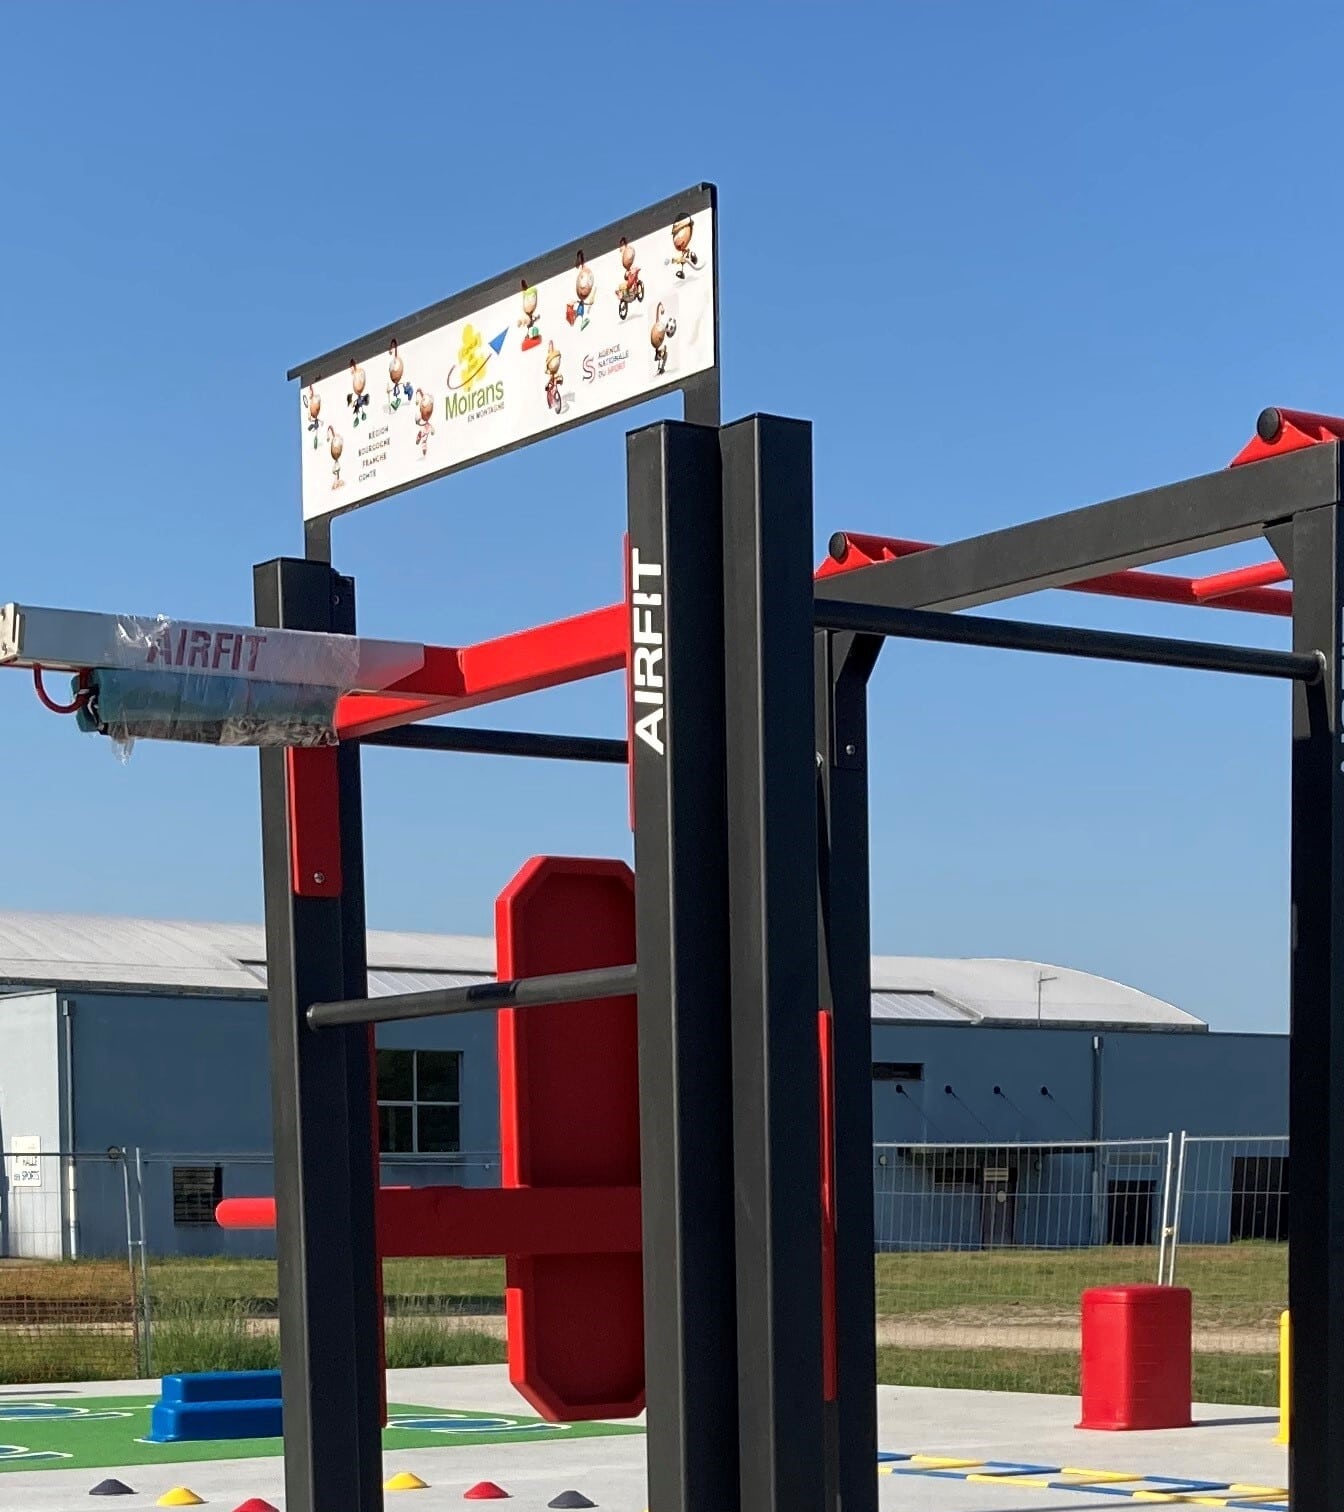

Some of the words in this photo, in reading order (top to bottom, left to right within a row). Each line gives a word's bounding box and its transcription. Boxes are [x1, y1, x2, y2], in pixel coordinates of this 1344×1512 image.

[445, 380, 504, 421] Moirans
[146, 628, 267, 673] AIRFIT
[632, 547, 664, 755] AIRFIT
